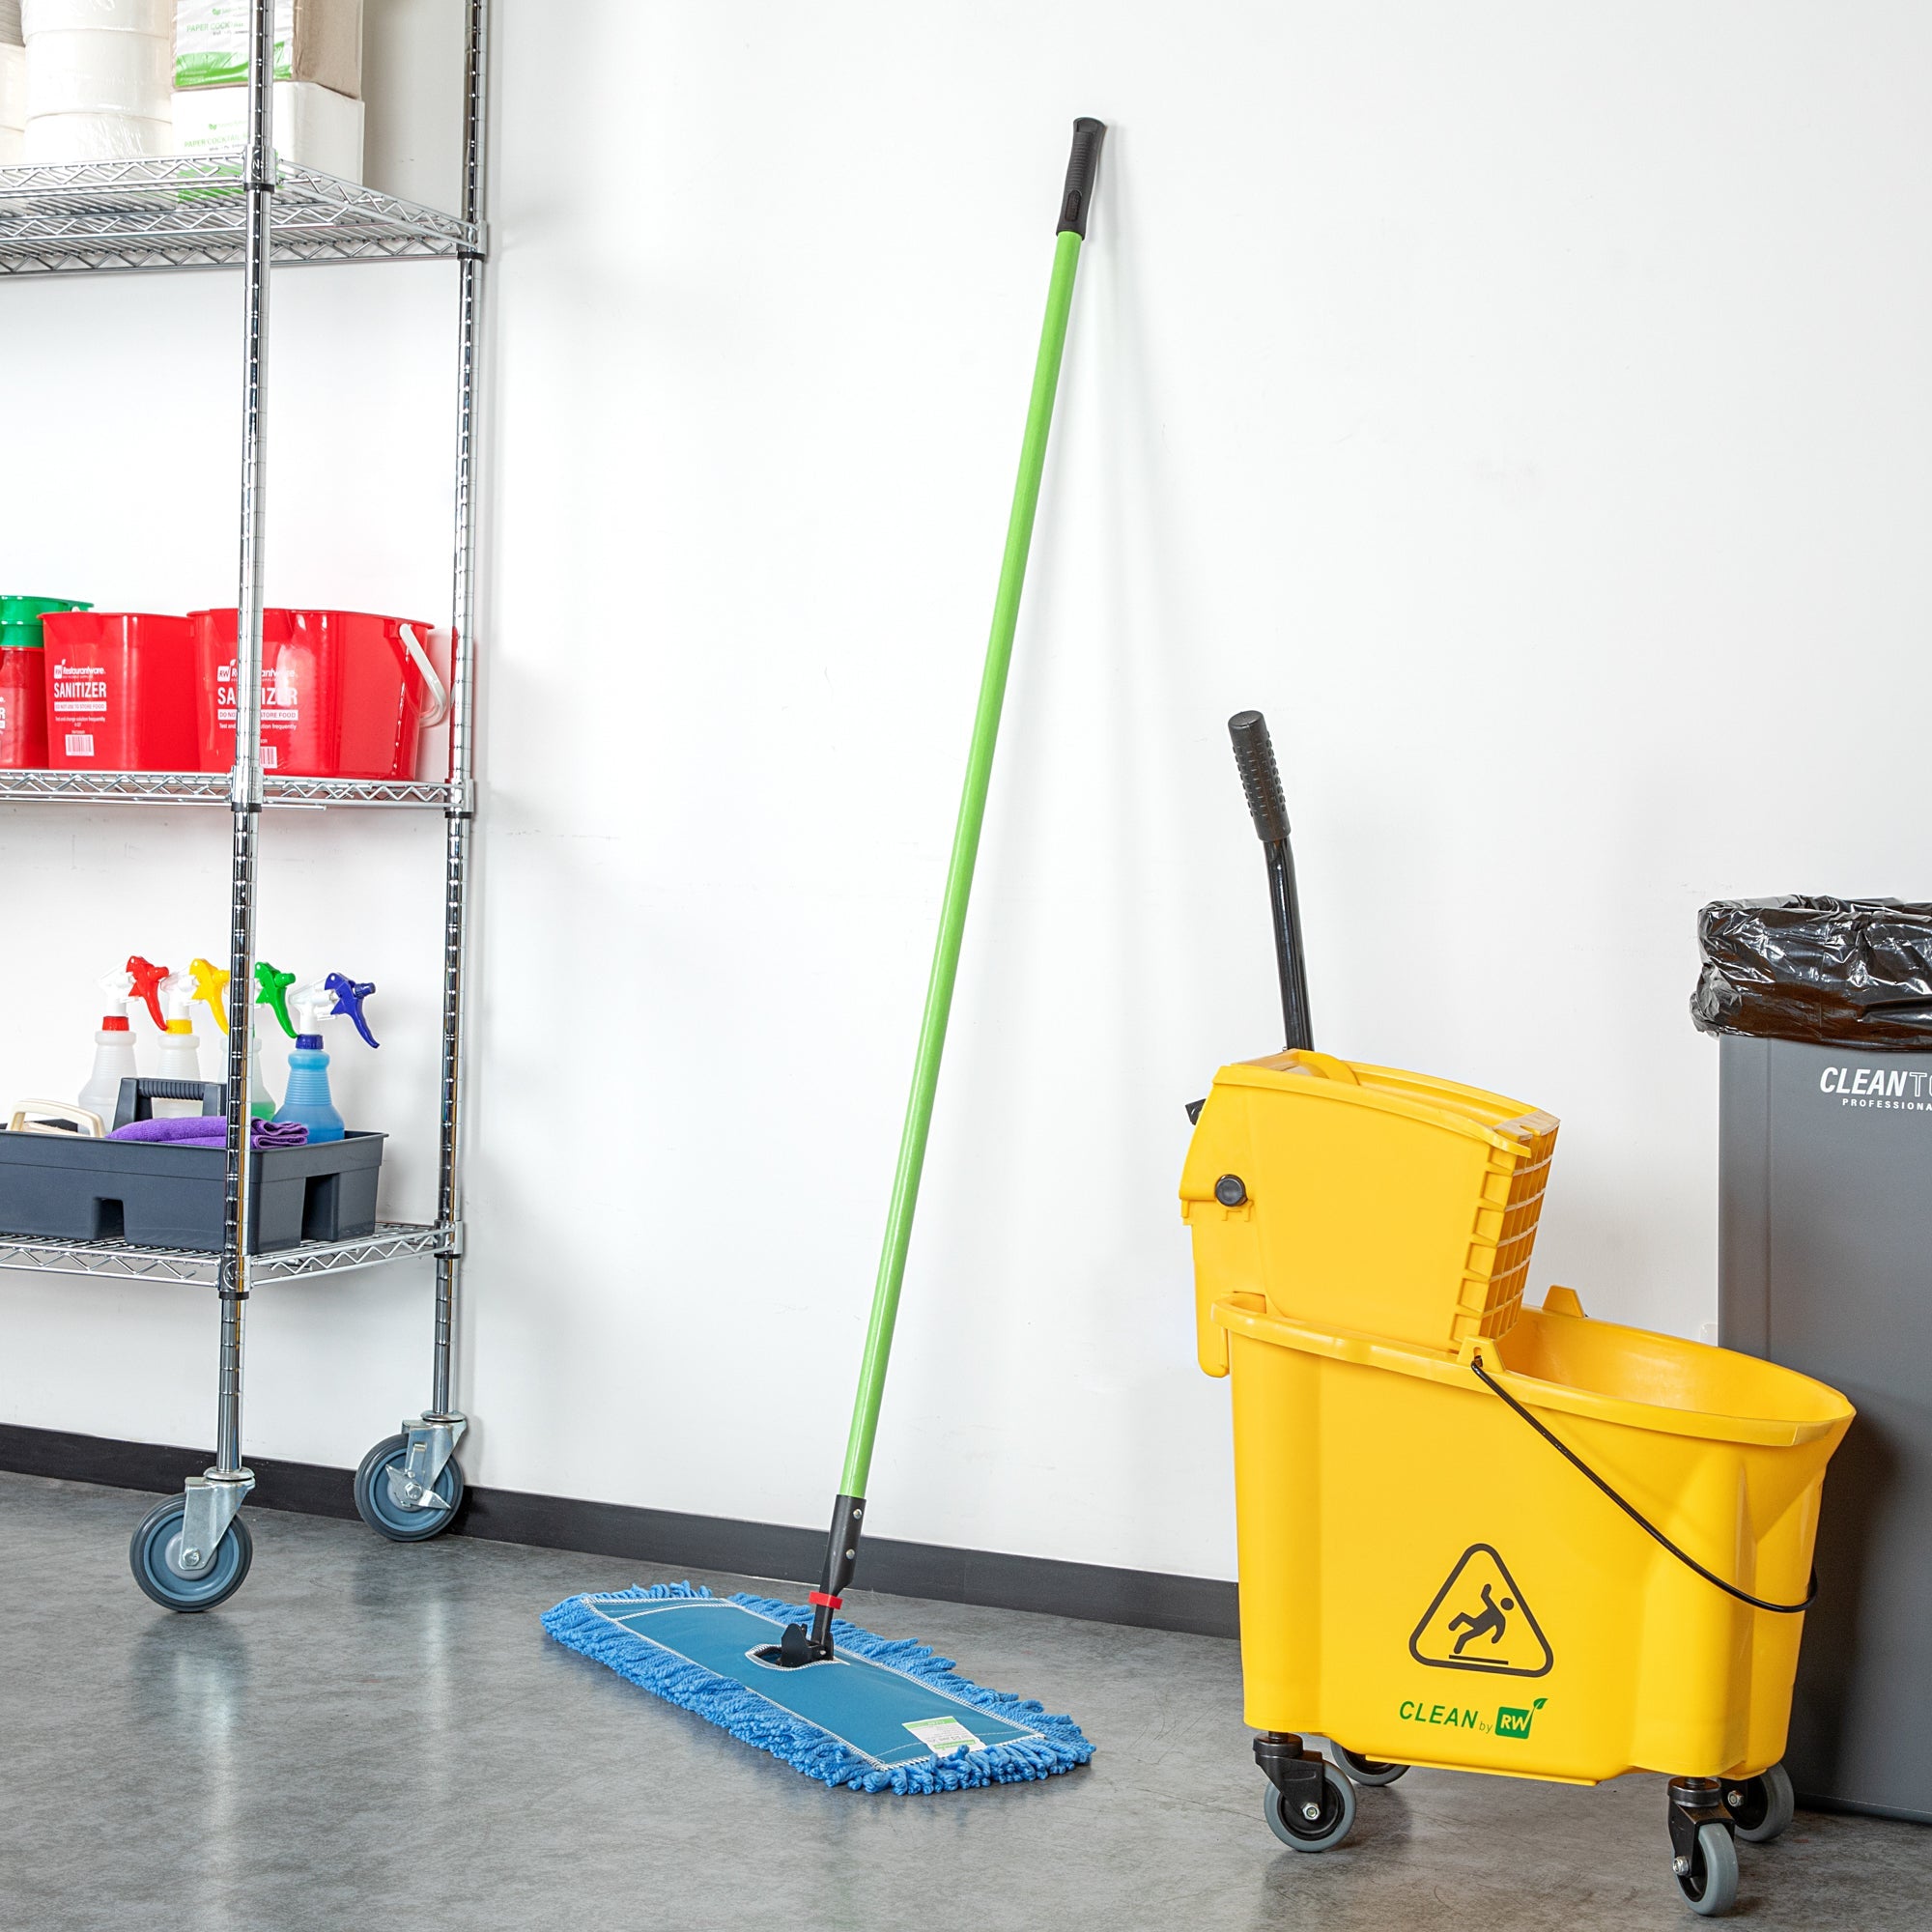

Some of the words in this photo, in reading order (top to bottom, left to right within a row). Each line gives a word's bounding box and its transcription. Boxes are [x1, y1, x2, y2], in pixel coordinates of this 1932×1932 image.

[54, 682, 106, 697] SANITIZER
[1399, 1700, 1479, 1729] CLEAN
[1479, 1720, 1493, 1735] by
